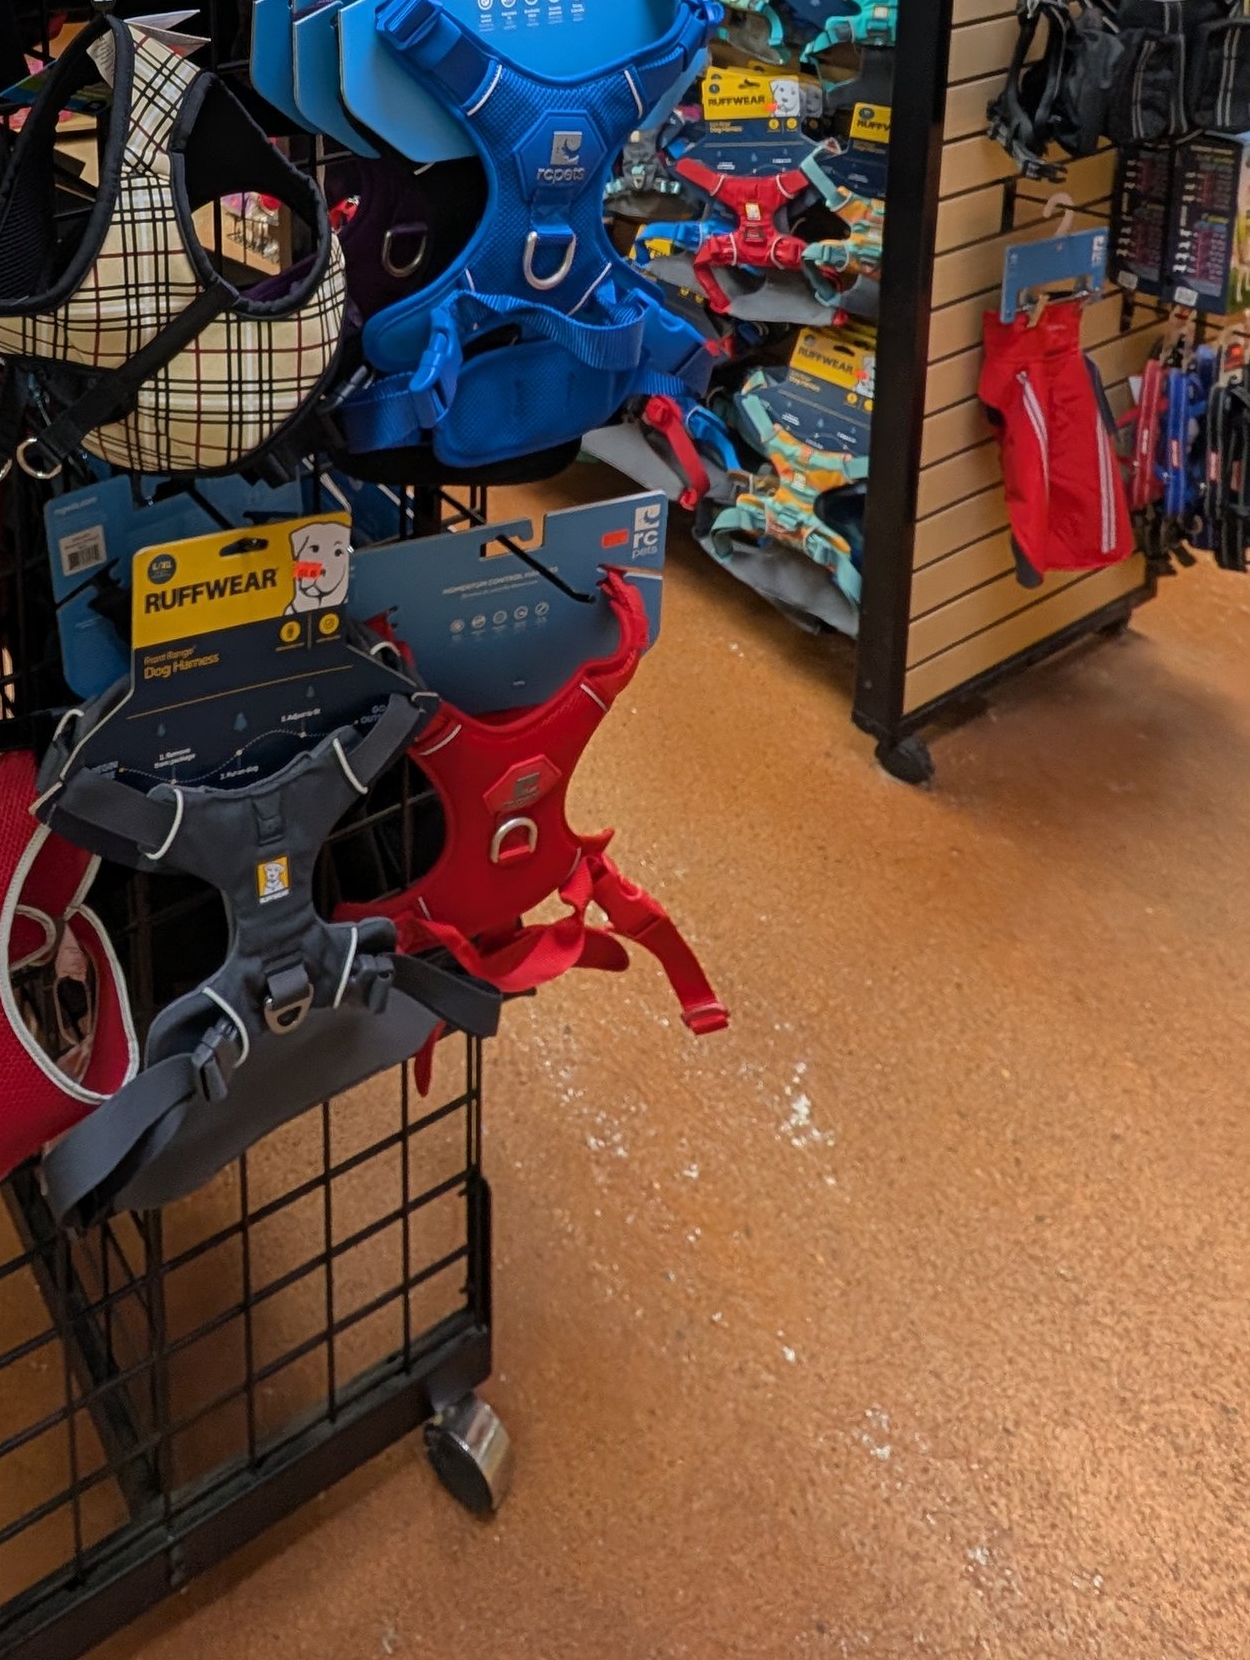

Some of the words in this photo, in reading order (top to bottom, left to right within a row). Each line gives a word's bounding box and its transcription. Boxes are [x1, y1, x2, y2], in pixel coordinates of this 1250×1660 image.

[708, 96, 765, 107] RUFFWEAR
[633, 530, 659, 549] rc
[144, 568, 277, 614] RUFFWEAR
[144, 661, 171, 680] Dog
[173, 652, 220, 673] Harness
